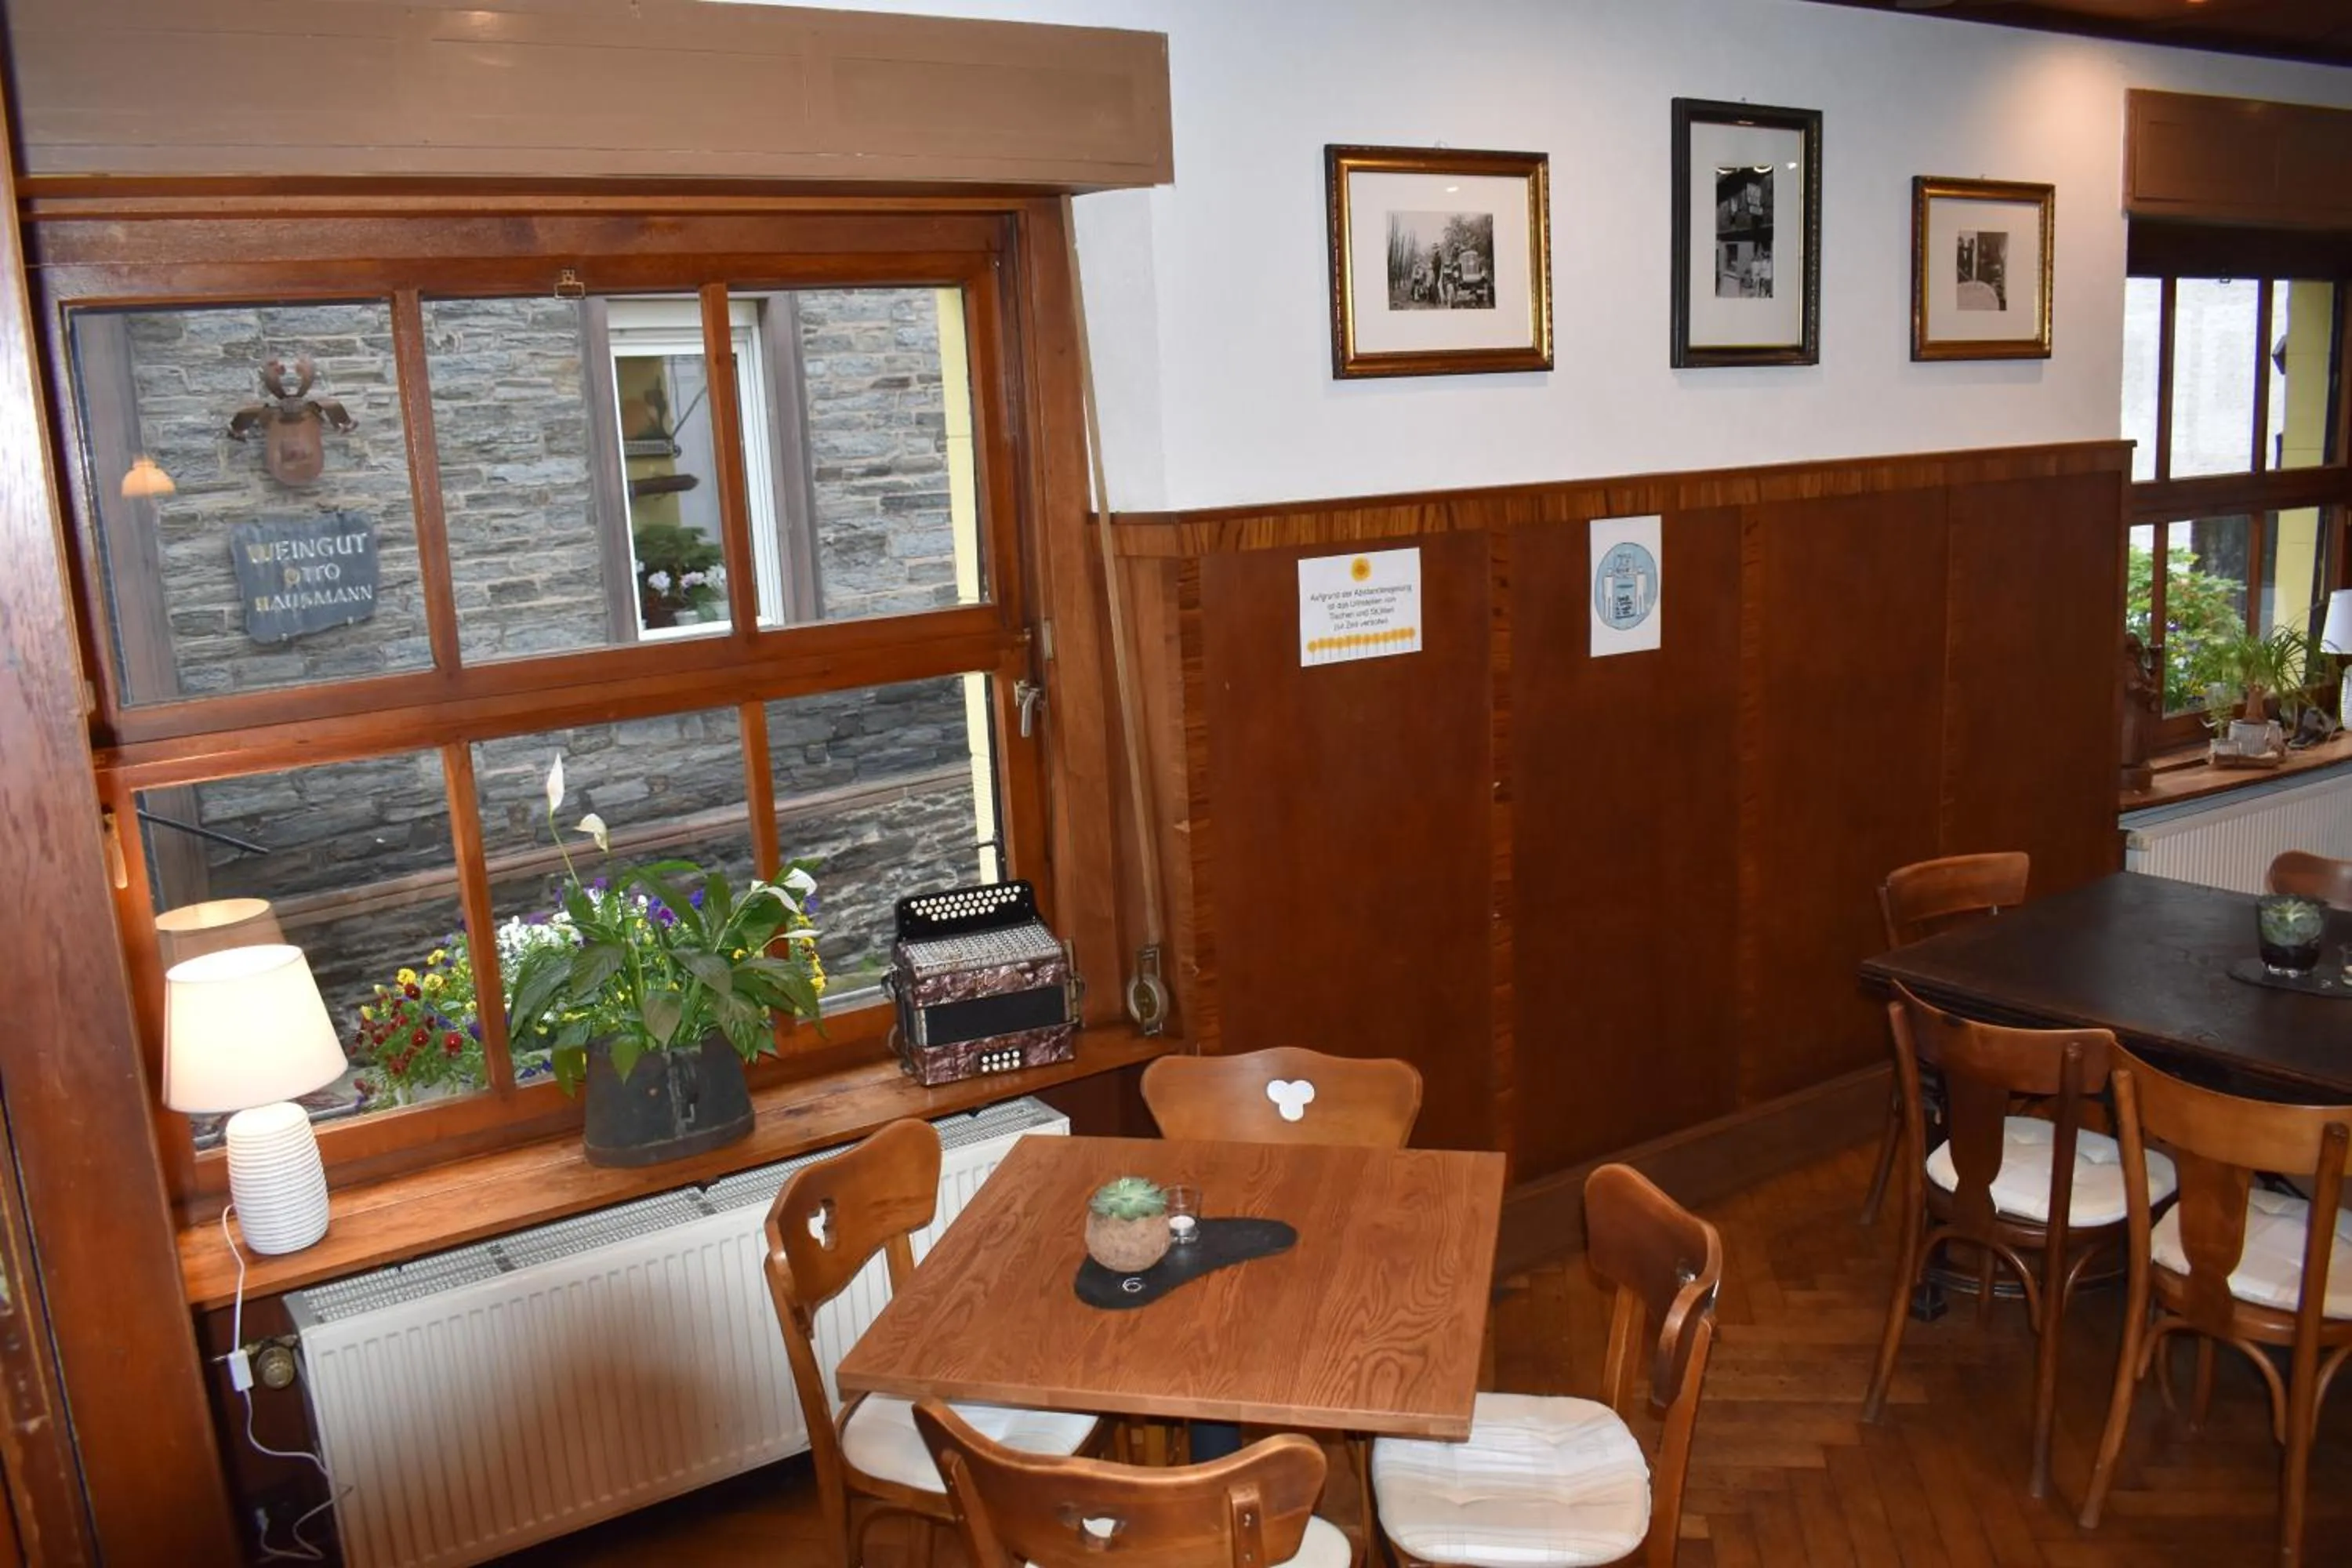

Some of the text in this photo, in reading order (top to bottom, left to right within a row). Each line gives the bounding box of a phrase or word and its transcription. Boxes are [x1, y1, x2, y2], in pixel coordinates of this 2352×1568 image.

[246, 532, 368, 564] WEINGUT
[283, 562, 341, 587] OTTO
[254, 584, 373, 612] HAUSMANN
[1123, 1276, 1142, 1293] 6
